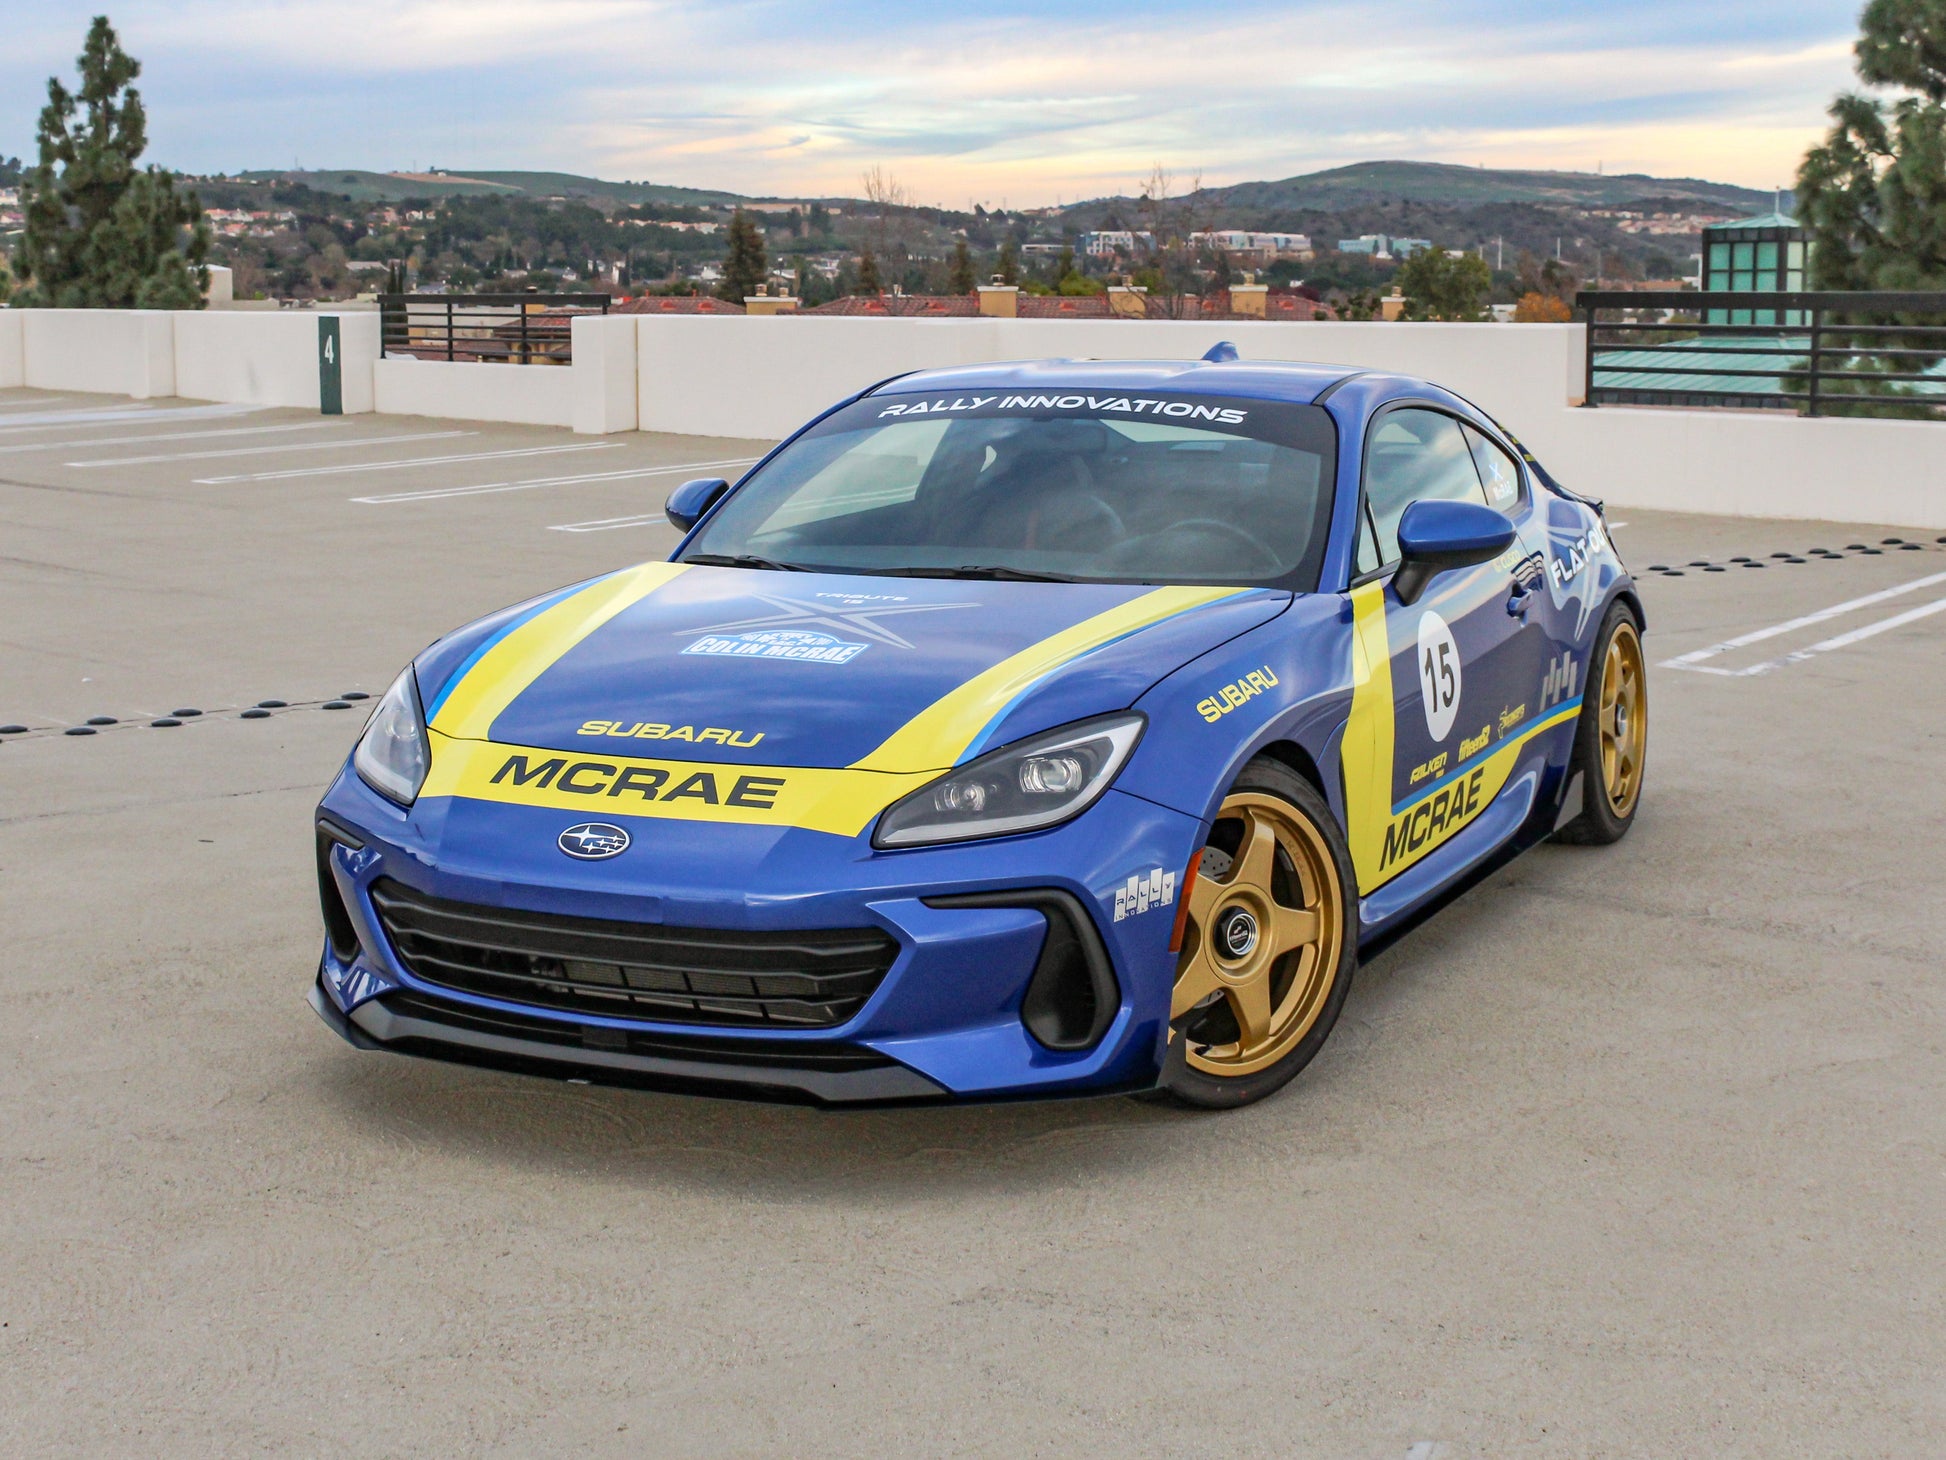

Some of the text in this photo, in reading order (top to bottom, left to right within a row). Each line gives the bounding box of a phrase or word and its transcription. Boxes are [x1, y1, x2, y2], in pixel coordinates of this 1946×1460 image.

[325, 335, 334, 364] 4
[878, 395, 1248, 425] RALLY INNOVATIONS
[1550, 537, 1589, 589] FLAT
[815, 592, 909, 602] TRIBUTE
[693, 637, 763, 655] COLIN
[763, 643, 861, 662] MCRAE
[1424, 642, 1455, 713] 15
[1196, 665, 1279, 723] SUBARU
[576, 720, 766, 748] SUBARU
[489, 755, 786, 809] MCRAE
[1379, 766, 1485, 872] MCRAE
[1116, 882, 1172, 906] RALLY
